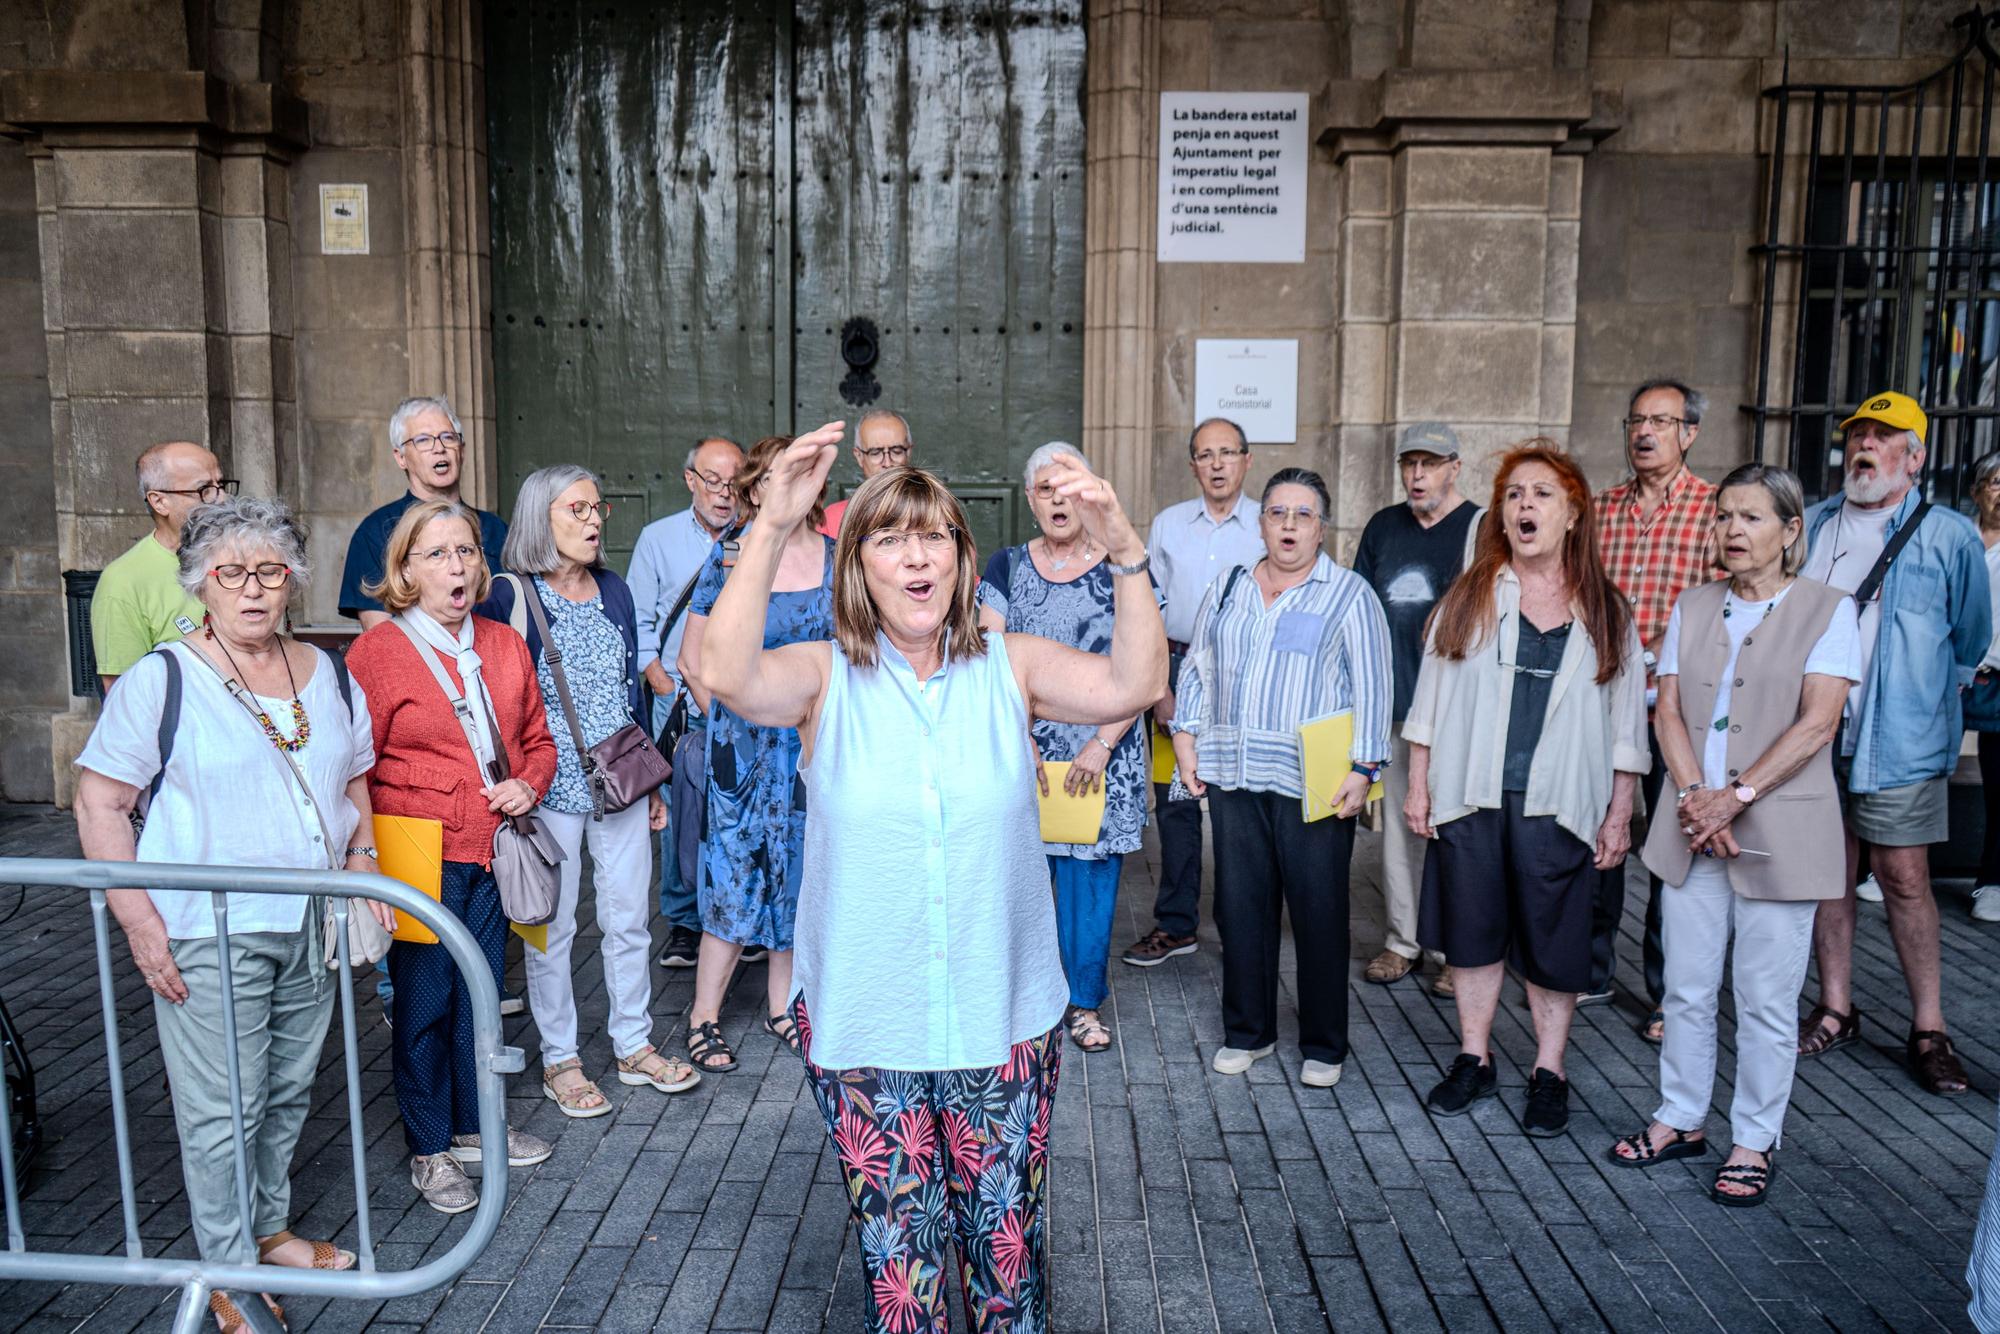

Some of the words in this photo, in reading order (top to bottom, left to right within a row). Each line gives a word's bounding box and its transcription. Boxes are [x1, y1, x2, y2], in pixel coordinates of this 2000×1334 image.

[1174, 109, 1189, 120] La
[1192, 109, 1248, 121] bandera
[1251, 109, 1296, 121] estatal
[1173, 128, 1211, 142] penja
[1214, 131, 1230, 139] en
[1234, 129, 1279, 142] aquest
[1173, 147, 1252, 160] Ajuntament
[1259, 150, 1281, 161] per
[1173, 166, 1238, 179] imperatiu
[1244, 166, 1276, 180] legal
[1172, 184, 1176, 195] i
[1179, 187, 1195, 195] en
[1199, 184, 1279, 198] compliment
[1214, 204, 1277, 214] sentència
[1171, 221, 1224, 235] judicial.
[1235, 384, 1258, 396] Casa
[1218, 398, 1272, 409] Consistorial
